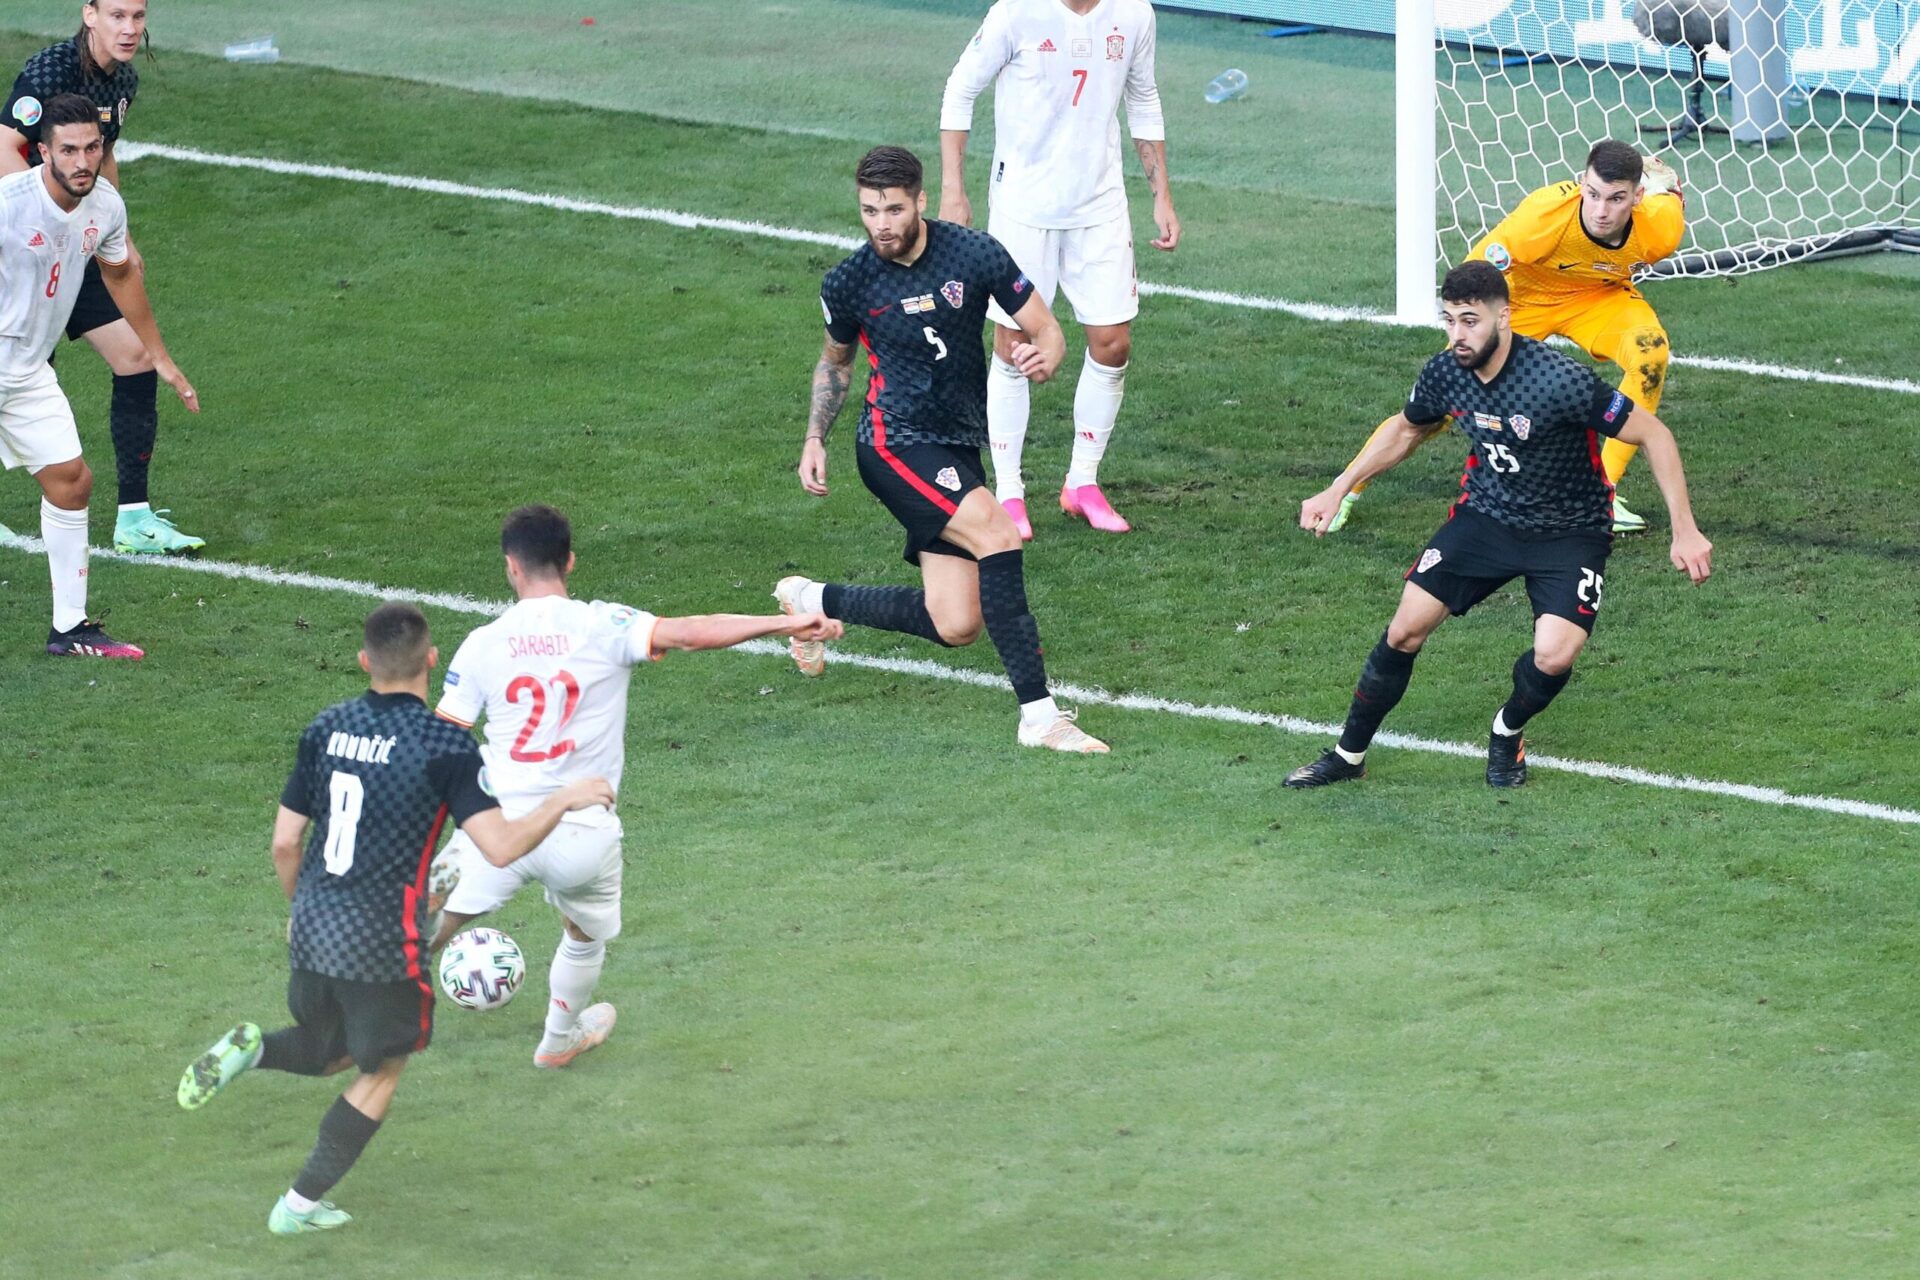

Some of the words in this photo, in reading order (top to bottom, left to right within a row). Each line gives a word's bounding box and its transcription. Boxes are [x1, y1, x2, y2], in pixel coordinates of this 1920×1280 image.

[1072, 69, 1087, 107] 7
[46, 260, 60, 298] 8
[922, 326, 948, 361] 5
[1481, 442, 1521, 473] 25
[1577, 566, 1604, 611] 25
[505, 669, 580, 762] 22
[323, 770, 365, 877] 8
